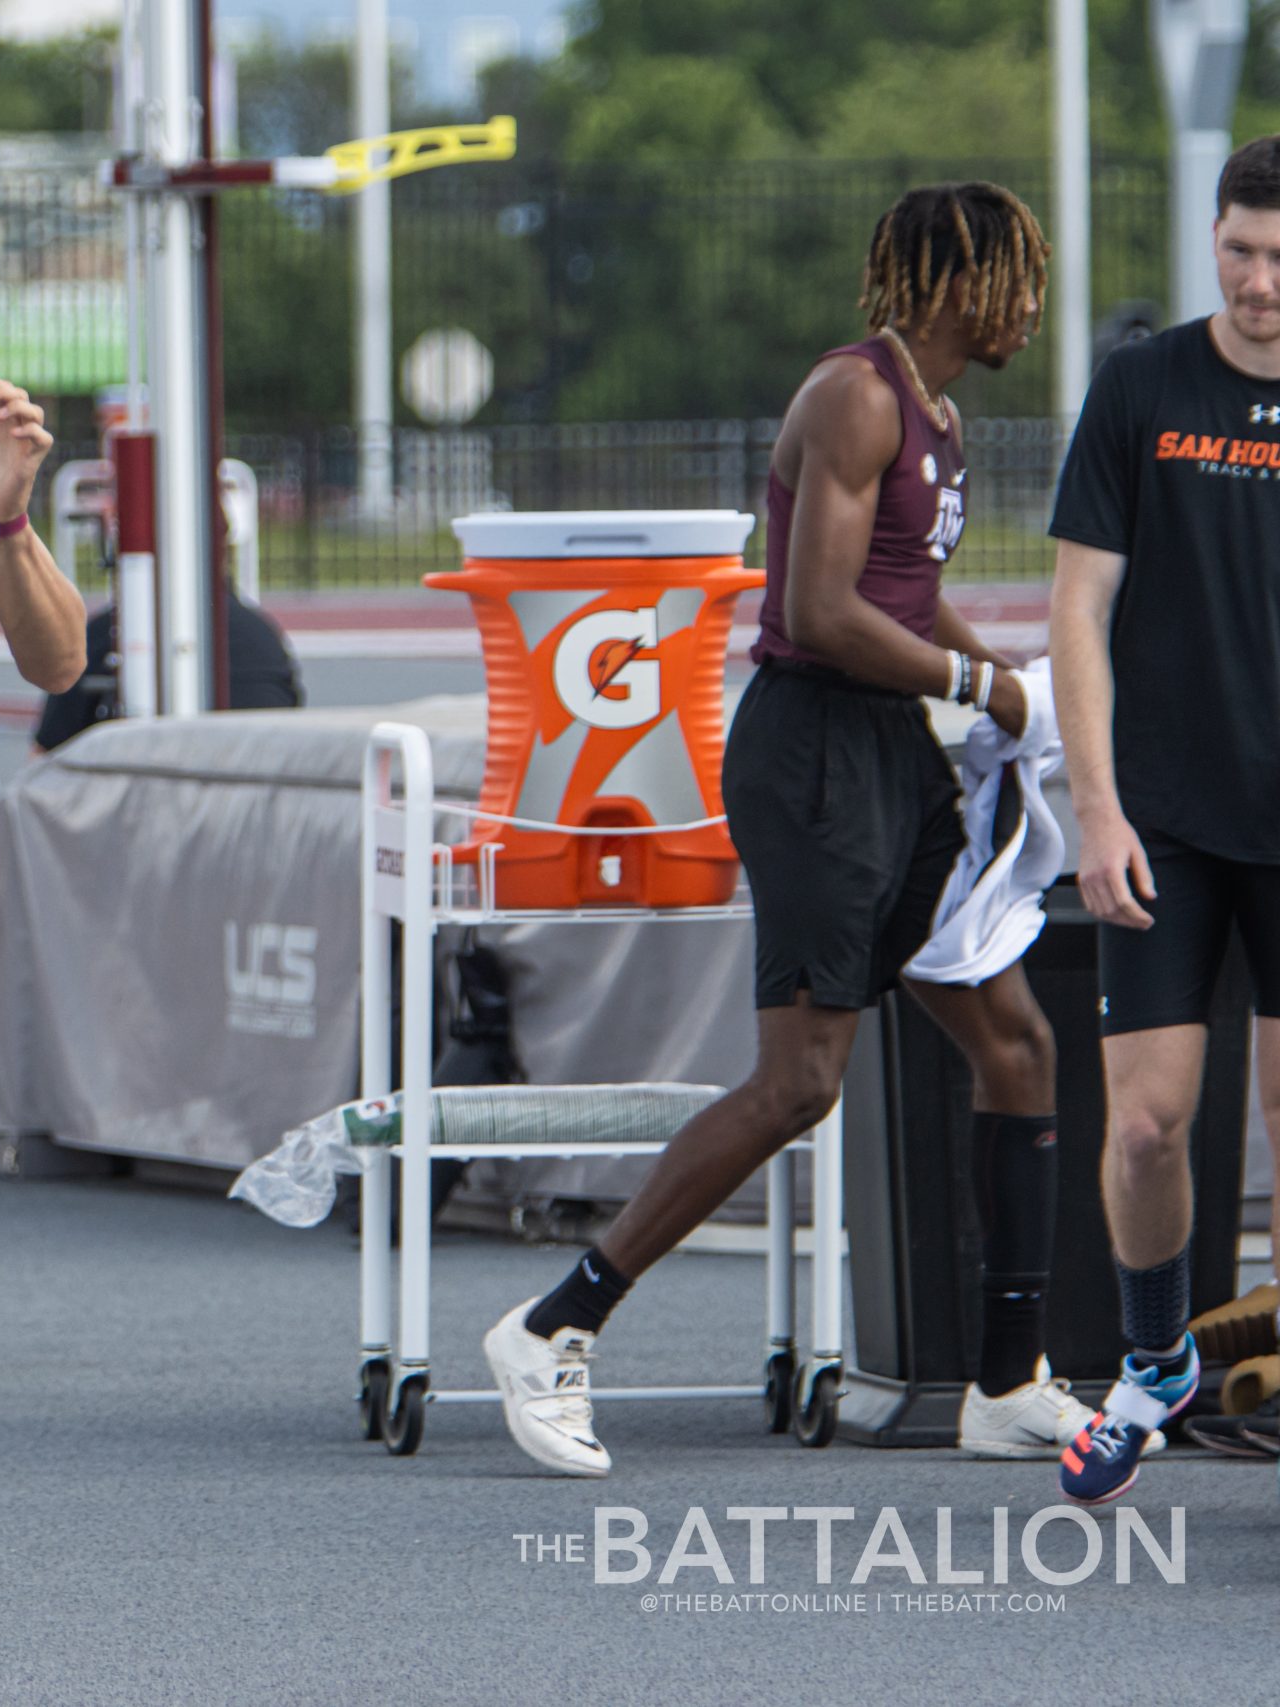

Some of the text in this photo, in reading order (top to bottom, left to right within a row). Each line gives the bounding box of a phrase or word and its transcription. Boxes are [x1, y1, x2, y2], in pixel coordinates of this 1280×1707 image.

[1156, 431, 1227, 460] SAM
[1199, 461, 1252, 477] TRACK
[553, 606, 661, 729] G
[223, 920, 318, 1002] UCS
